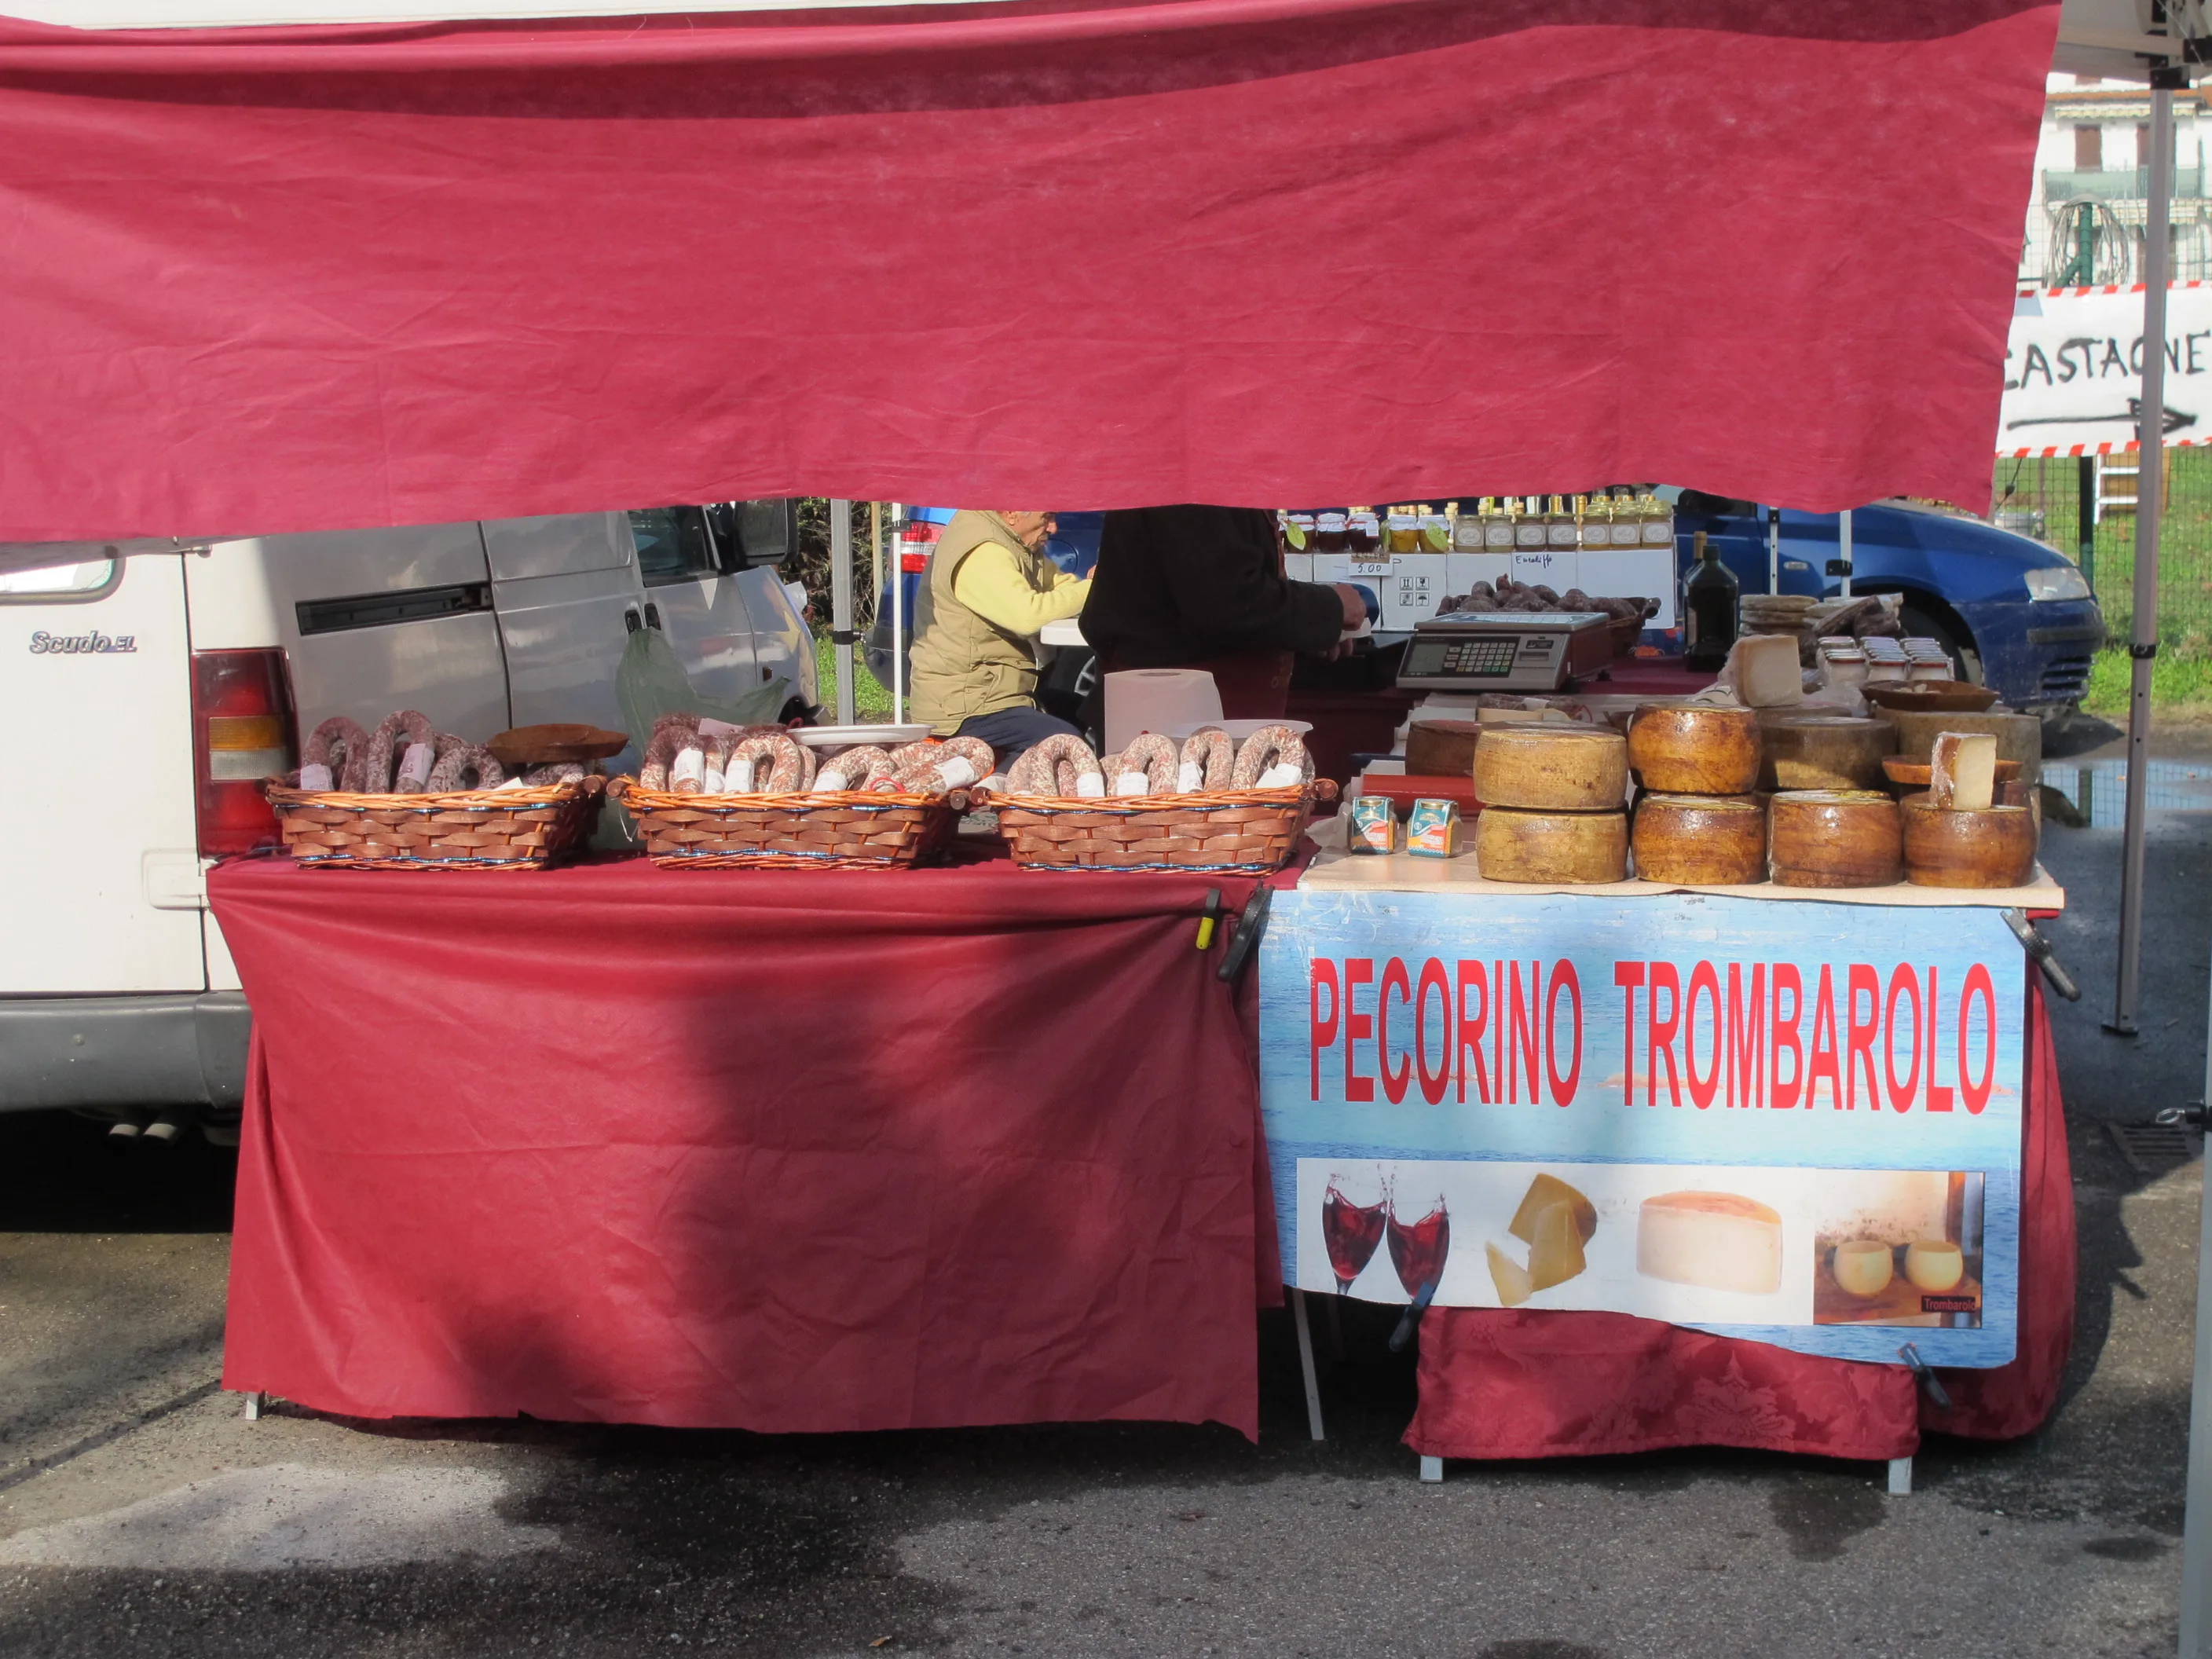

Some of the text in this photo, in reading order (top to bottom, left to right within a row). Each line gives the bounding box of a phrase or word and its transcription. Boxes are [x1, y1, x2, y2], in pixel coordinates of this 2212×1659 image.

[29, 630, 137, 654] Scudo EL
[1310, 956, 1997, 1115] PECORINO TROMBAROLO
[1924, 1298, 1977, 1311] Trombarolo
